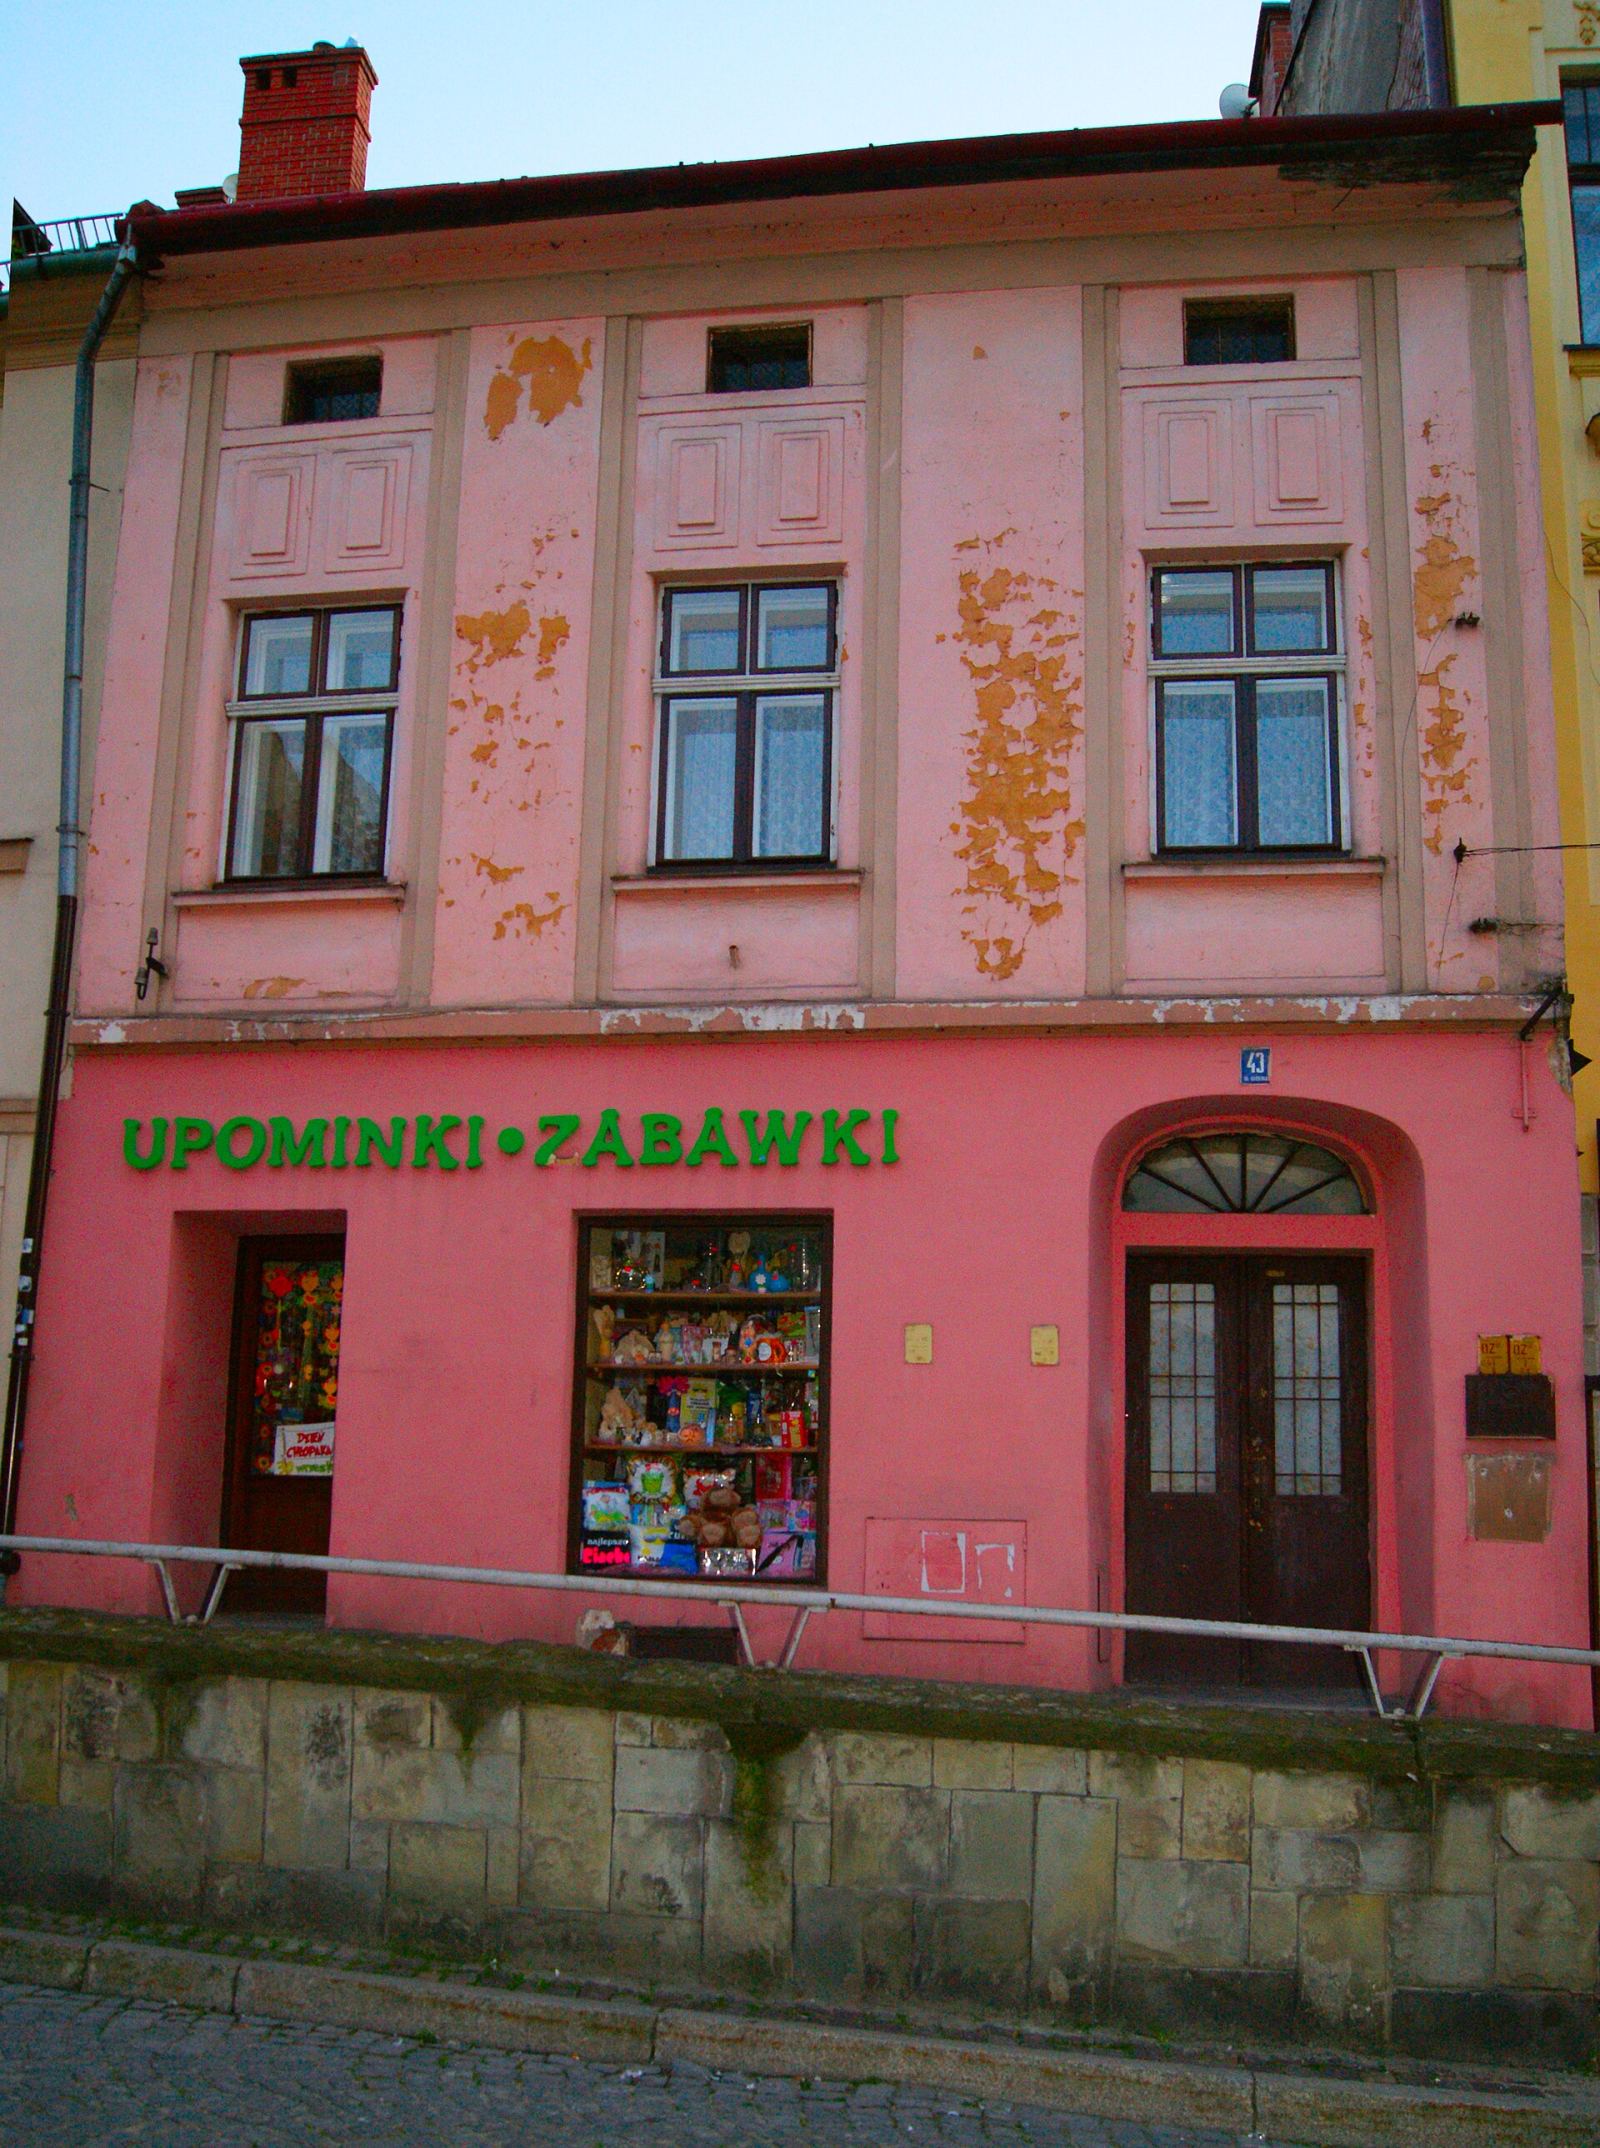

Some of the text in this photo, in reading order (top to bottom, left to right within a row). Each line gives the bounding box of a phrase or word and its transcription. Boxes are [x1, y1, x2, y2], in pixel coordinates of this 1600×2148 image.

[1246, 1052, 1265, 1073] 43
[123, 1108, 899, 1169] UPOMINKI ZABAWKI
